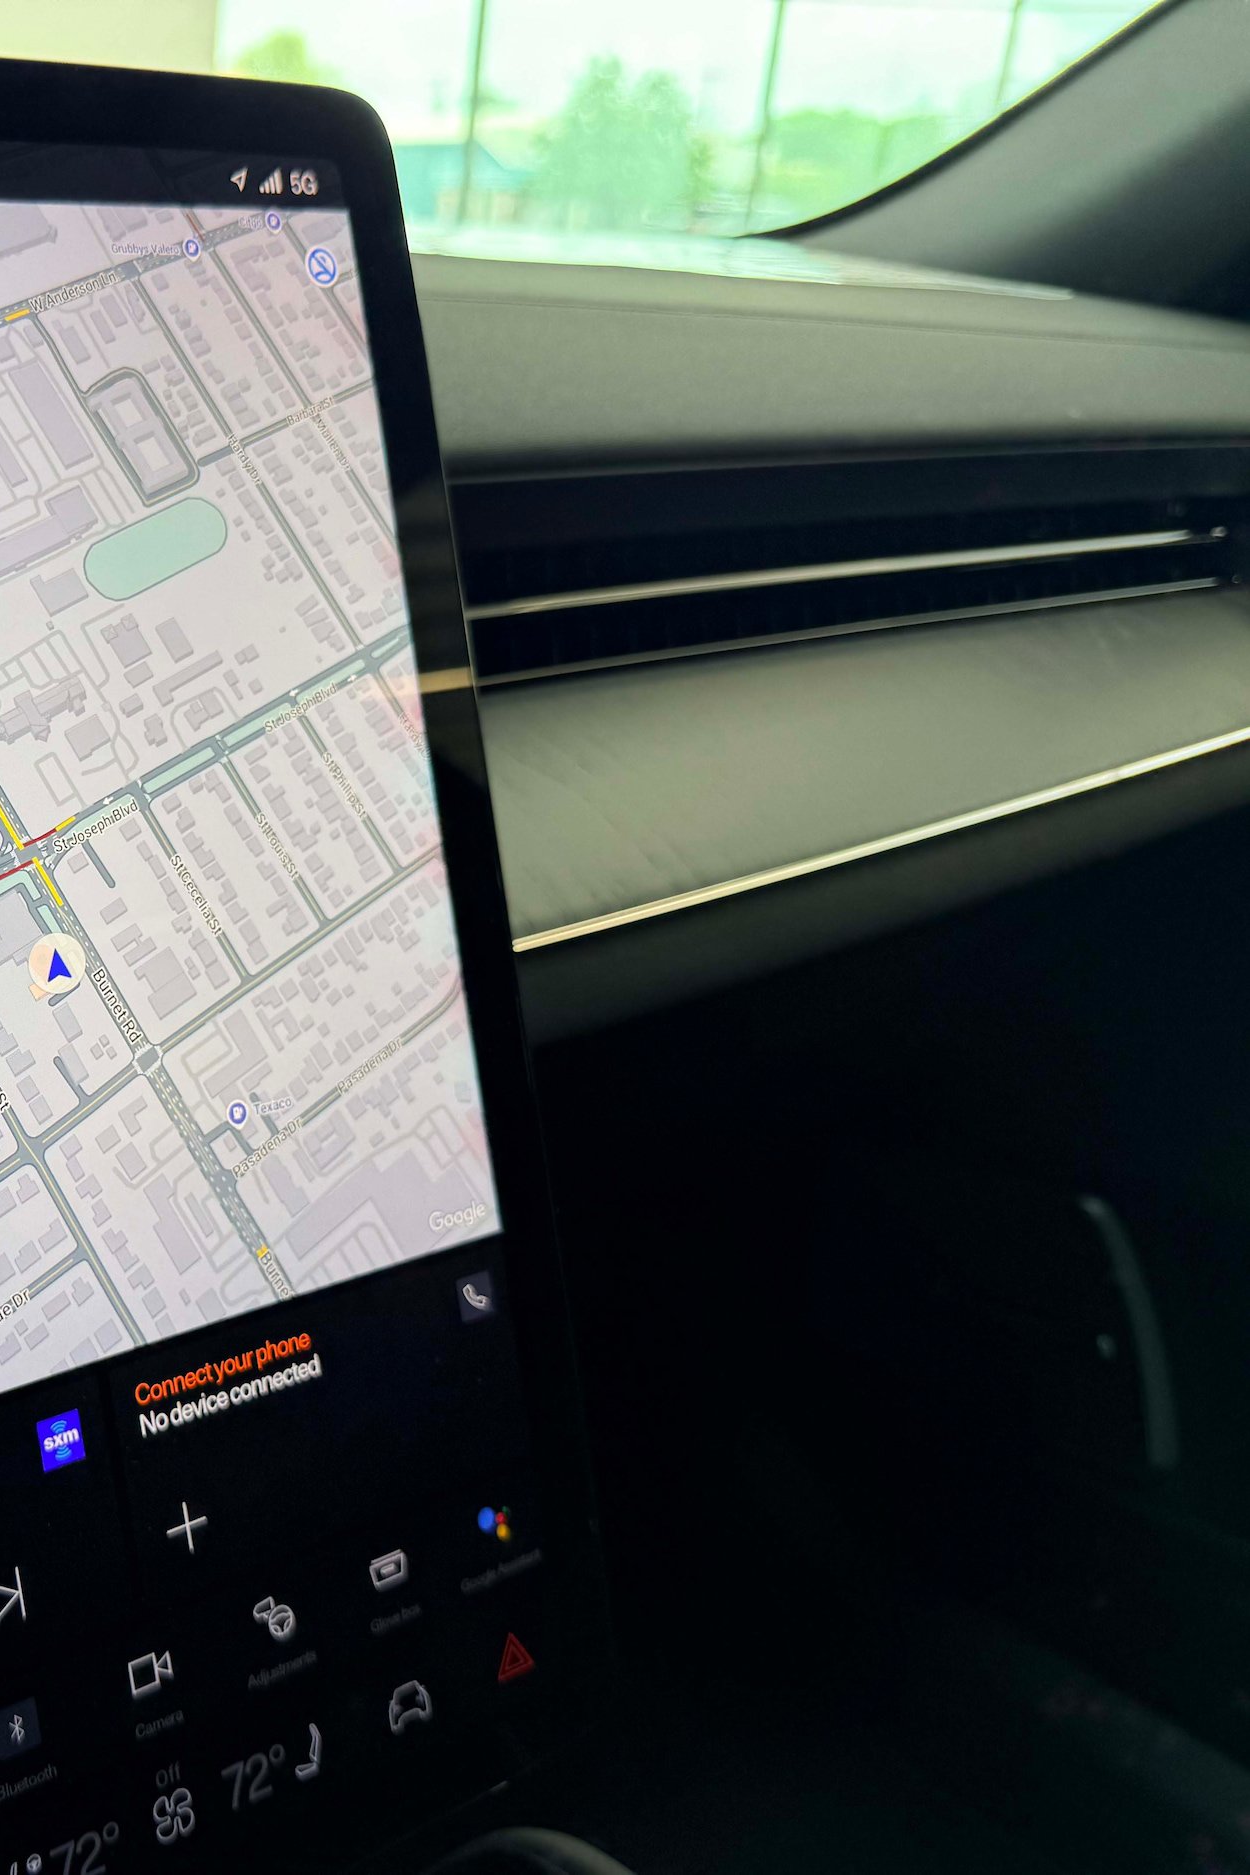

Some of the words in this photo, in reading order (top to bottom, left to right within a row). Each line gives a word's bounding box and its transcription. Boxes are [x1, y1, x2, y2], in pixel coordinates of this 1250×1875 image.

[289, 169, 320, 196] 5G
[111, 244, 149, 257] Grubbys
[151, 244, 180, 256] Valero
[30, 299, 45, 312] W
[46, 278, 100, 307] Anderson
[100, 271, 117, 286] Ln
[287, 402, 324, 425] Barbara
[228, 434, 253, 473] Hardy
[278, 698, 317, 726] Joseph
[315, 684, 337, 704] Blvd
[53, 838, 71, 853] St
[71, 812, 113, 846] Joseph
[112, 800, 139, 823] Blvd
[265, 834, 292, 865] Louis
[170, 855, 186, 875] St
[180, 871, 214, 921] Cecelia
[207, 915, 222, 936] St
[92, 968, 128, 1021] Burnet
[121, 1016, 141, 1044] Rd
[338, 1045, 393, 1094] Pasadena
[387, 1037, 402, 1058] Dr
[254, 1097, 293, 1115] Texaco
[232, 1126, 291, 1178] Pasadena
[285, 1118, 302, 1139] Dr
[429, 1202, 487, 1232] Google
[11, 1289, 30, 1309] Dr
[135, 1363, 214, 1405] Connect
[211, 1350, 254, 1385] your
[255, 1330, 312, 1370] phone
[138, 1409, 171, 1438] No
[170, 1383, 230, 1425] device
[229, 1353, 322, 1404] connected
[43, 1427, 80, 1451] sxm
[247, 1648, 319, 1692] Adjustments
[134, 1708, 186, 1742] Camera
[154, 1761, 183, 1789] Off
[220, 1742, 287, 1812] 72°
